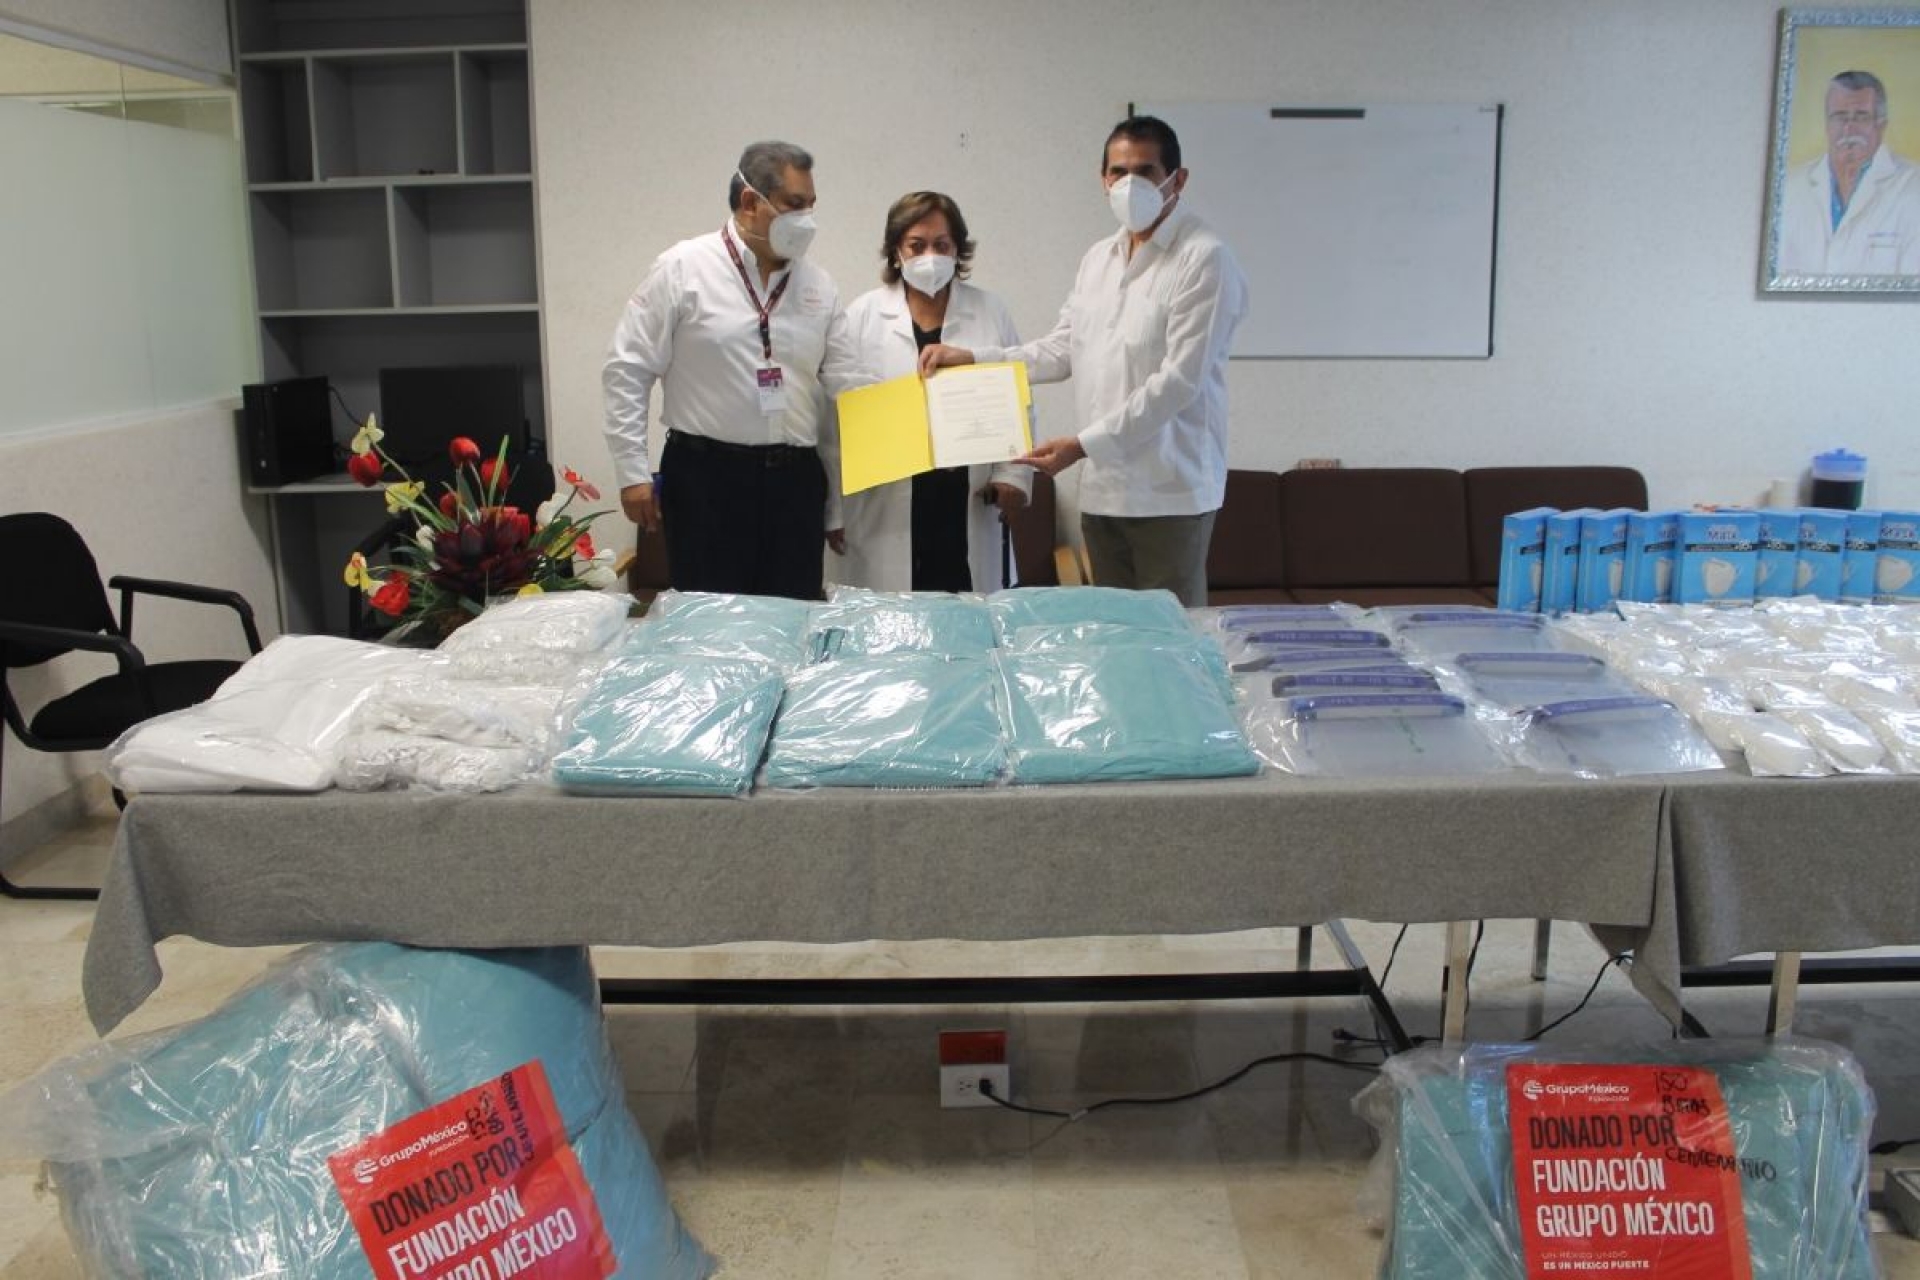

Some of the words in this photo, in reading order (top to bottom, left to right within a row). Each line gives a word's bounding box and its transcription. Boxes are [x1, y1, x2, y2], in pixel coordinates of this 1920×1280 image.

[1546, 1083, 1630, 1095] GrupoMéxico
[1653, 1072, 1688, 1093] 150
[379, 1121, 467, 1167] GrupoMéxico
[1529, 1115, 1622, 1150] DONADO
[1628, 1114, 1678, 1147] POR
[370, 1161, 473, 1235] DONADO
[473, 1136, 523, 1185] POR
[1532, 1152, 1666, 1194] FUNDACIÓN
[388, 1184, 525, 1280] FUNDACIÓN
[1536, 1204, 1617, 1238] GRUPO
[1623, 1196, 1715, 1236] MÉXICO
[491, 1208, 577, 1280] MÉXICO
[1543, 1261, 1556, 1270] ES
[1558, 1261, 1572, 1270] UN
[1610, 1260, 1649, 1269] FUERTE
